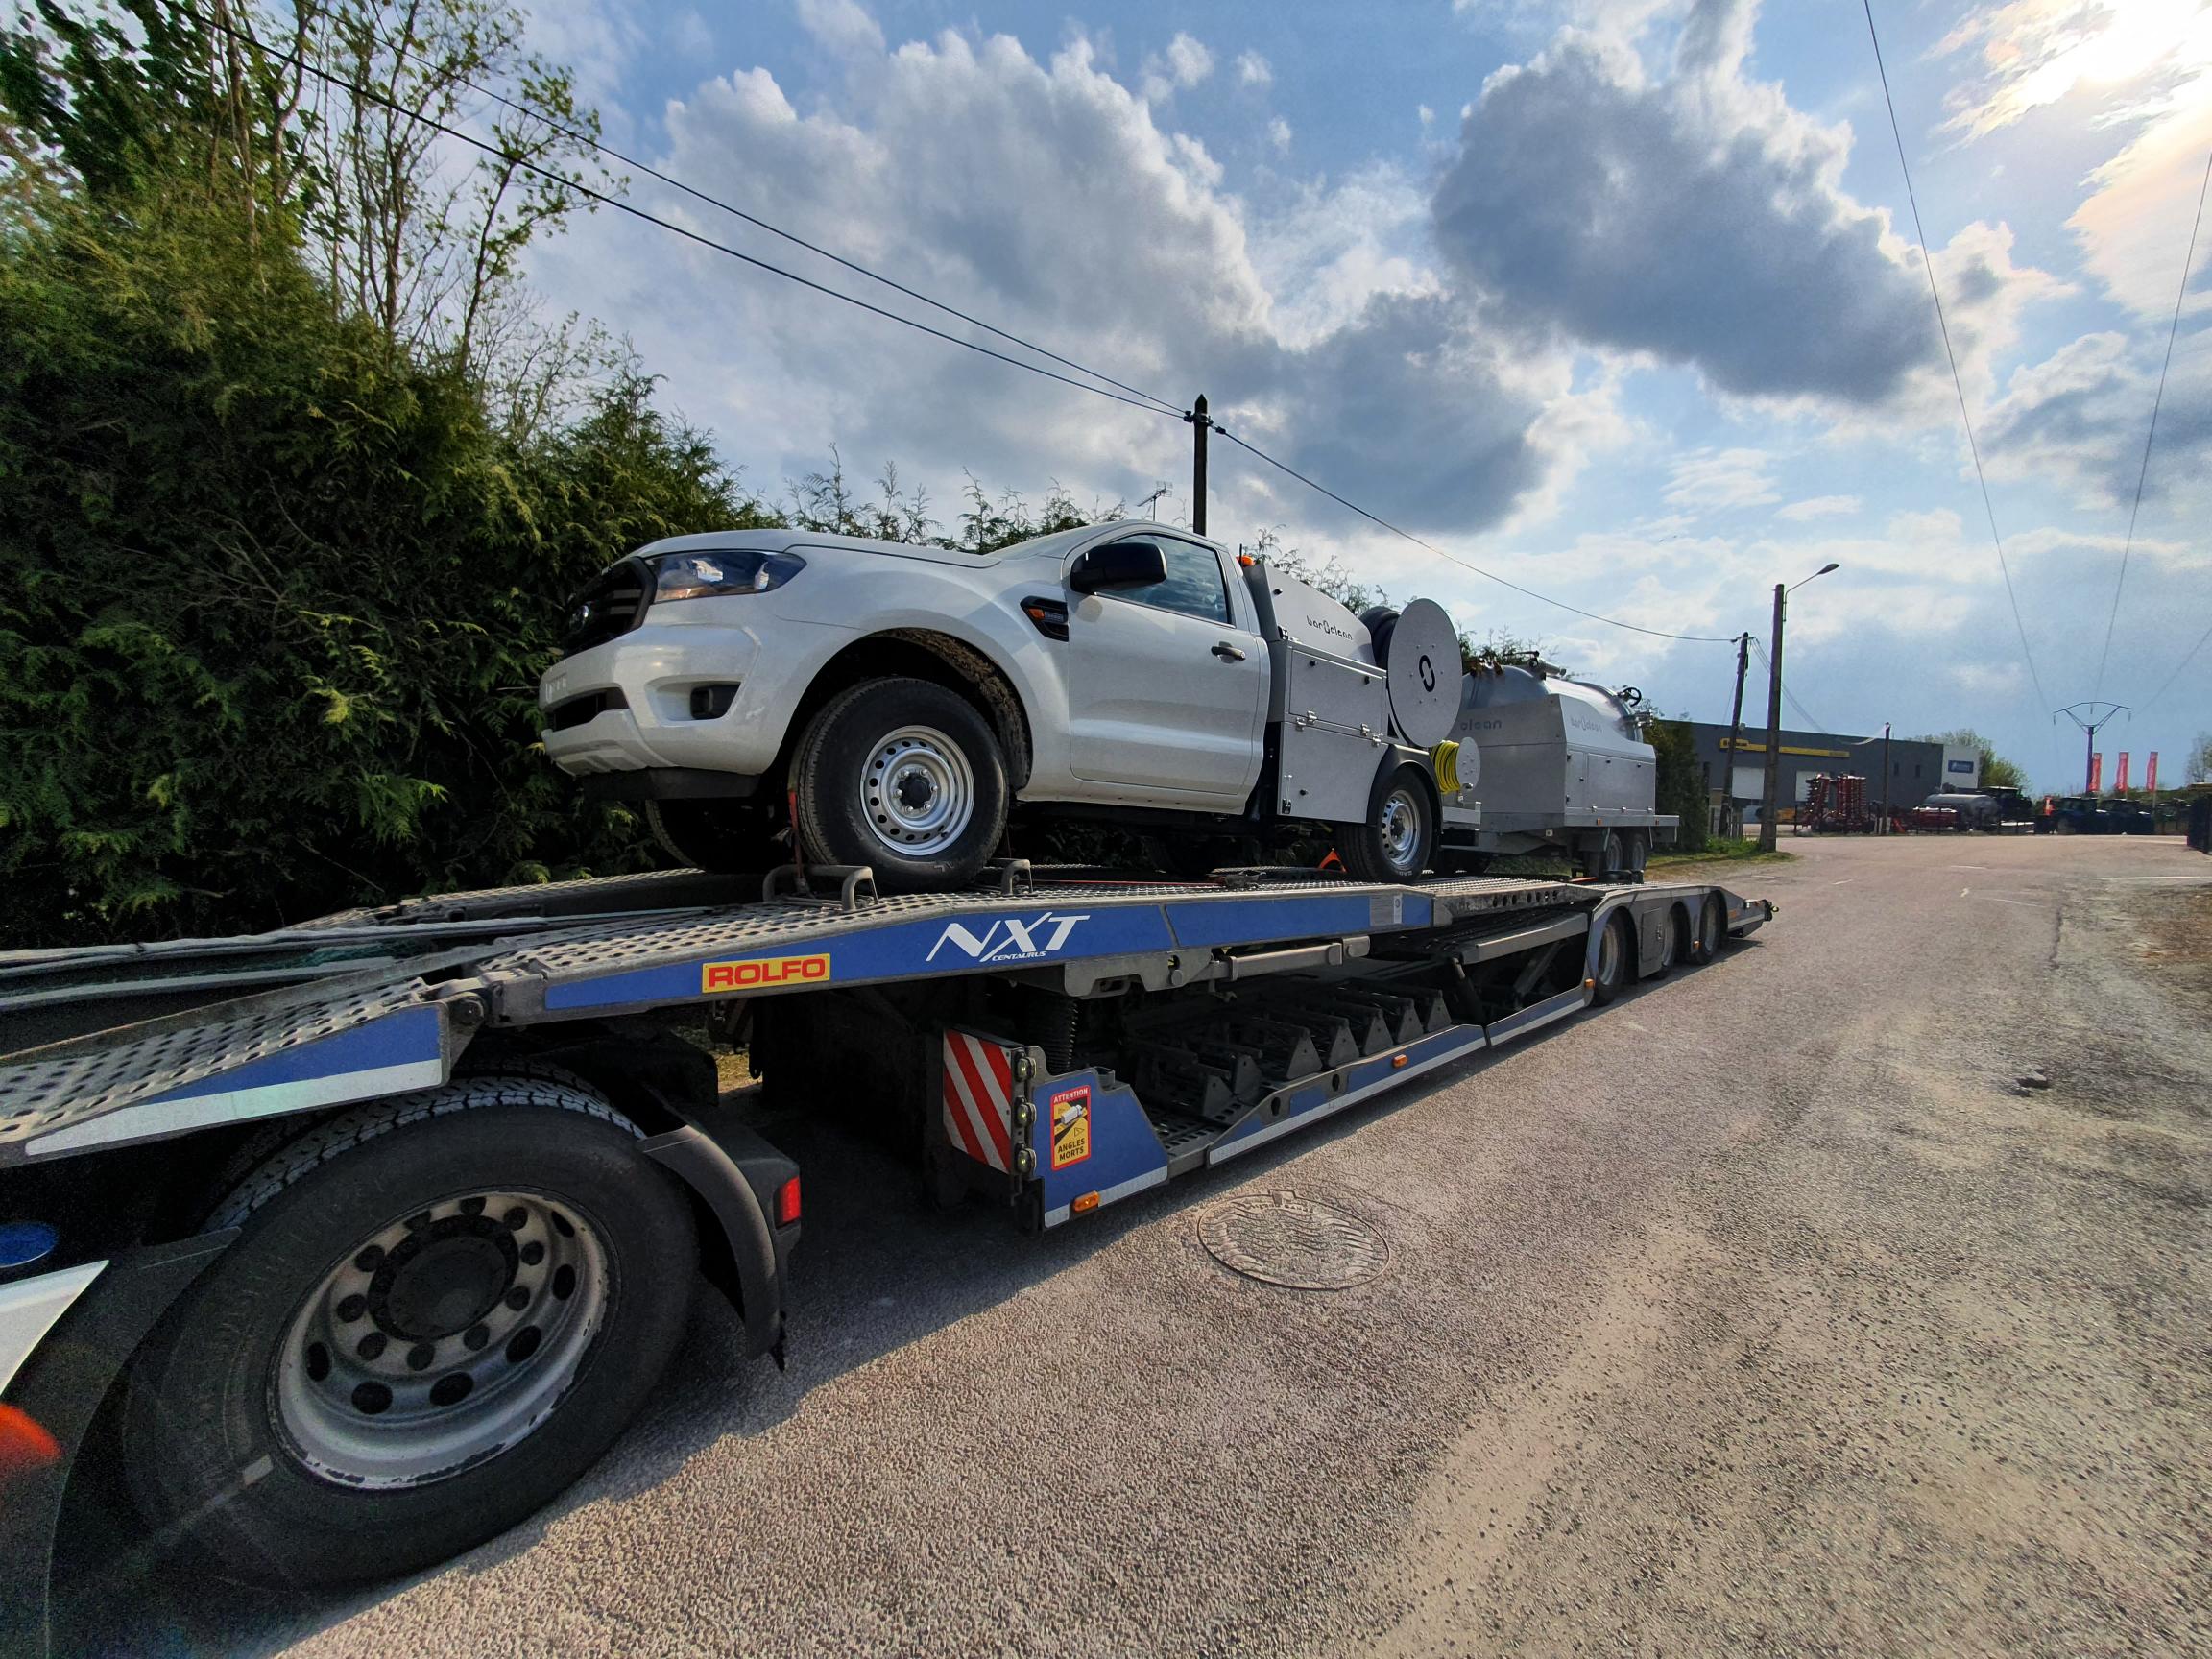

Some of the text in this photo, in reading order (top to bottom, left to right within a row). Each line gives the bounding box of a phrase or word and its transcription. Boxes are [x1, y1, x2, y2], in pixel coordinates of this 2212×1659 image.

[926, 911, 1091, 963] NXT
[992, 950, 1046, 961] CENTAURUS
[709, 958, 826, 988] ROLFO
[1053, 1087, 1089, 1104] ATTENTION
[1058, 1138, 1086, 1154] ANGLES
[1059, 1145, 1084, 1162] MORTS
